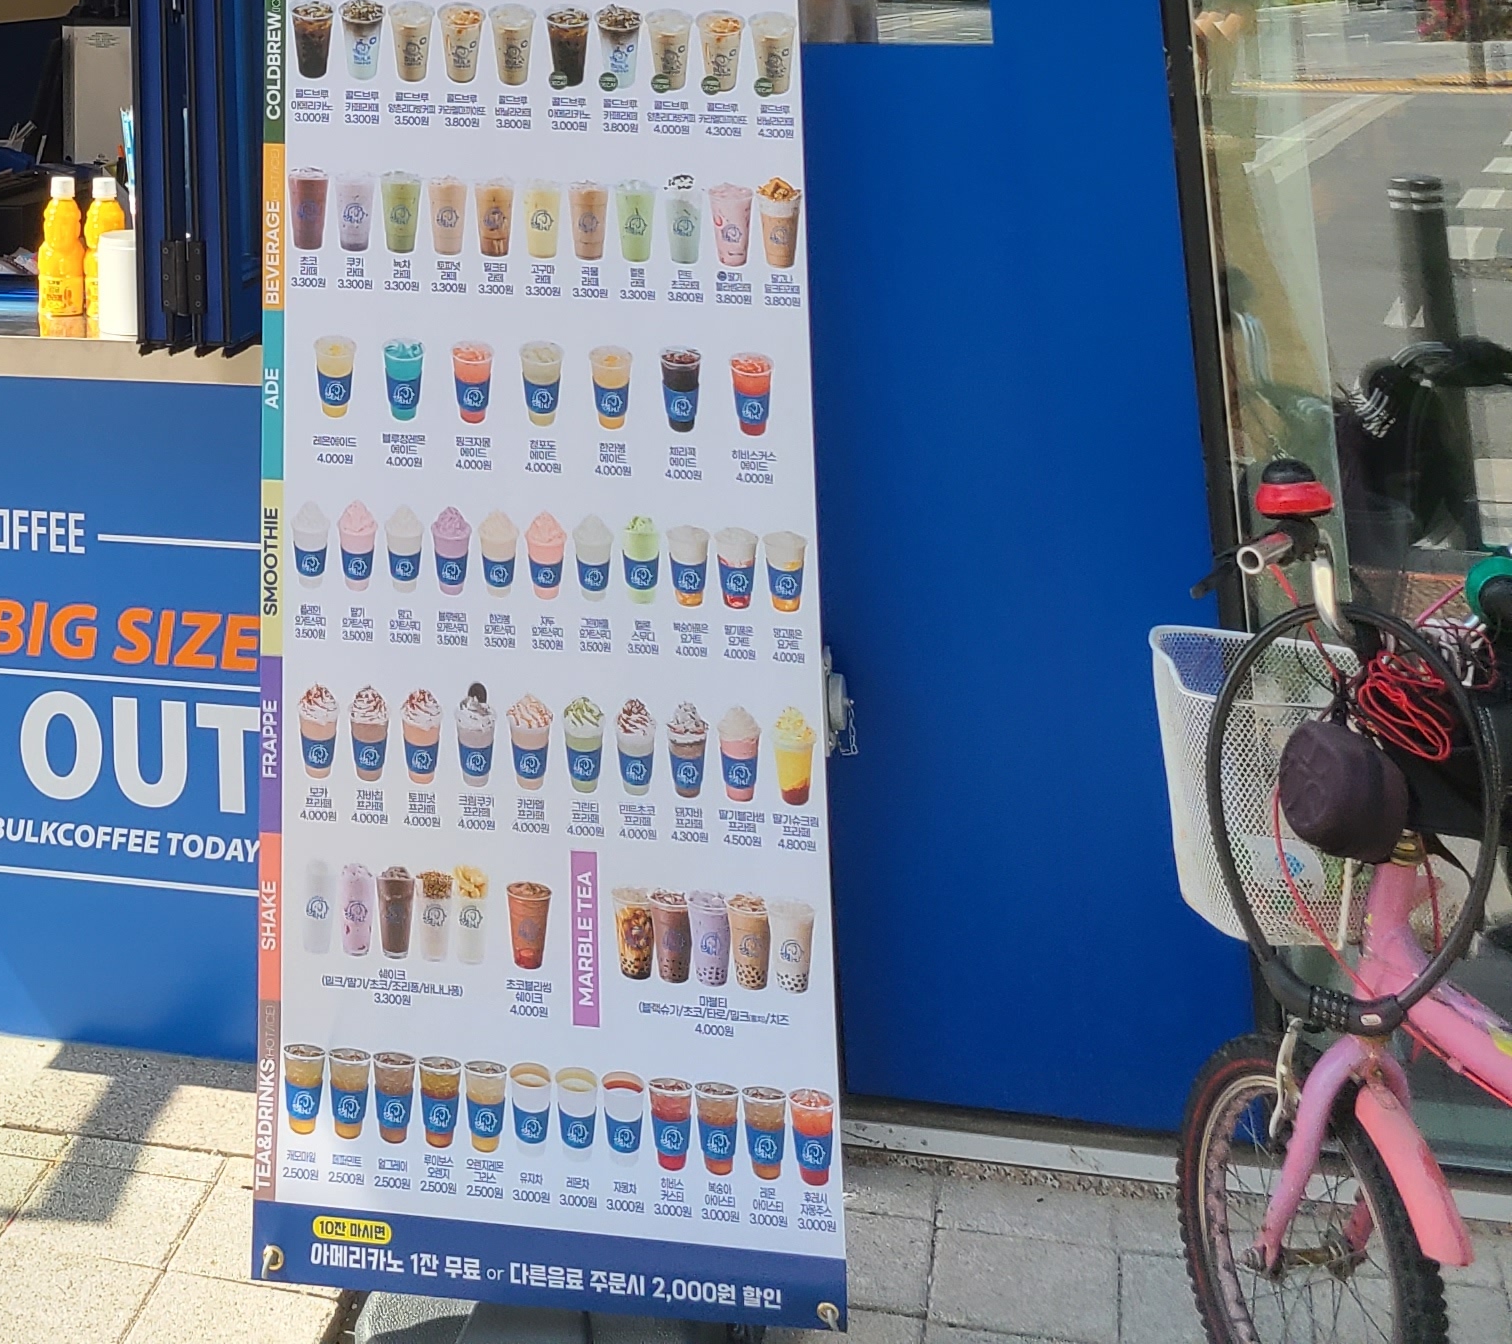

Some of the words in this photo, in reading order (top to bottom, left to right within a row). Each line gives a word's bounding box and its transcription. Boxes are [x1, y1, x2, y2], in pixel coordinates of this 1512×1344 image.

[264, 368, 279, 409] ADE
[317, 454, 353, 465] 4.000원
[263, 508, 279, 616] SMOOTHIE
[112, 608, 260, 672] SIZE
[19, 690, 260, 814] OUT
[262, 700, 278, 778] FRAPPE
[300, 810, 337, 822] 4.000원
[166, 831, 260, 863] TODAY
[261, 881, 277, 951] SHAKE
[577, 871, 592, 913] TEA
[578, 917, 594, 1007] MARBLE
[374, 993, 411, 1006] 3.300원
[319, 1220, 346, 1237] 10잔
[350, 1225, 386, 1240] 마시면
[310, 1243, 404, 1273] 아메리카노
[410, 1253, 439, 1277] 1잔
[444, 1256, 481, 1281] 무료
[487, 1267, 504, 1281] or
[510, 1261, 584, 1291] 다른음료
[590, 1269, 645, 1296] 주문시
[652, 1277, 736, 1305] 2,000원
[743, 1286, 782, 1310] 할인
